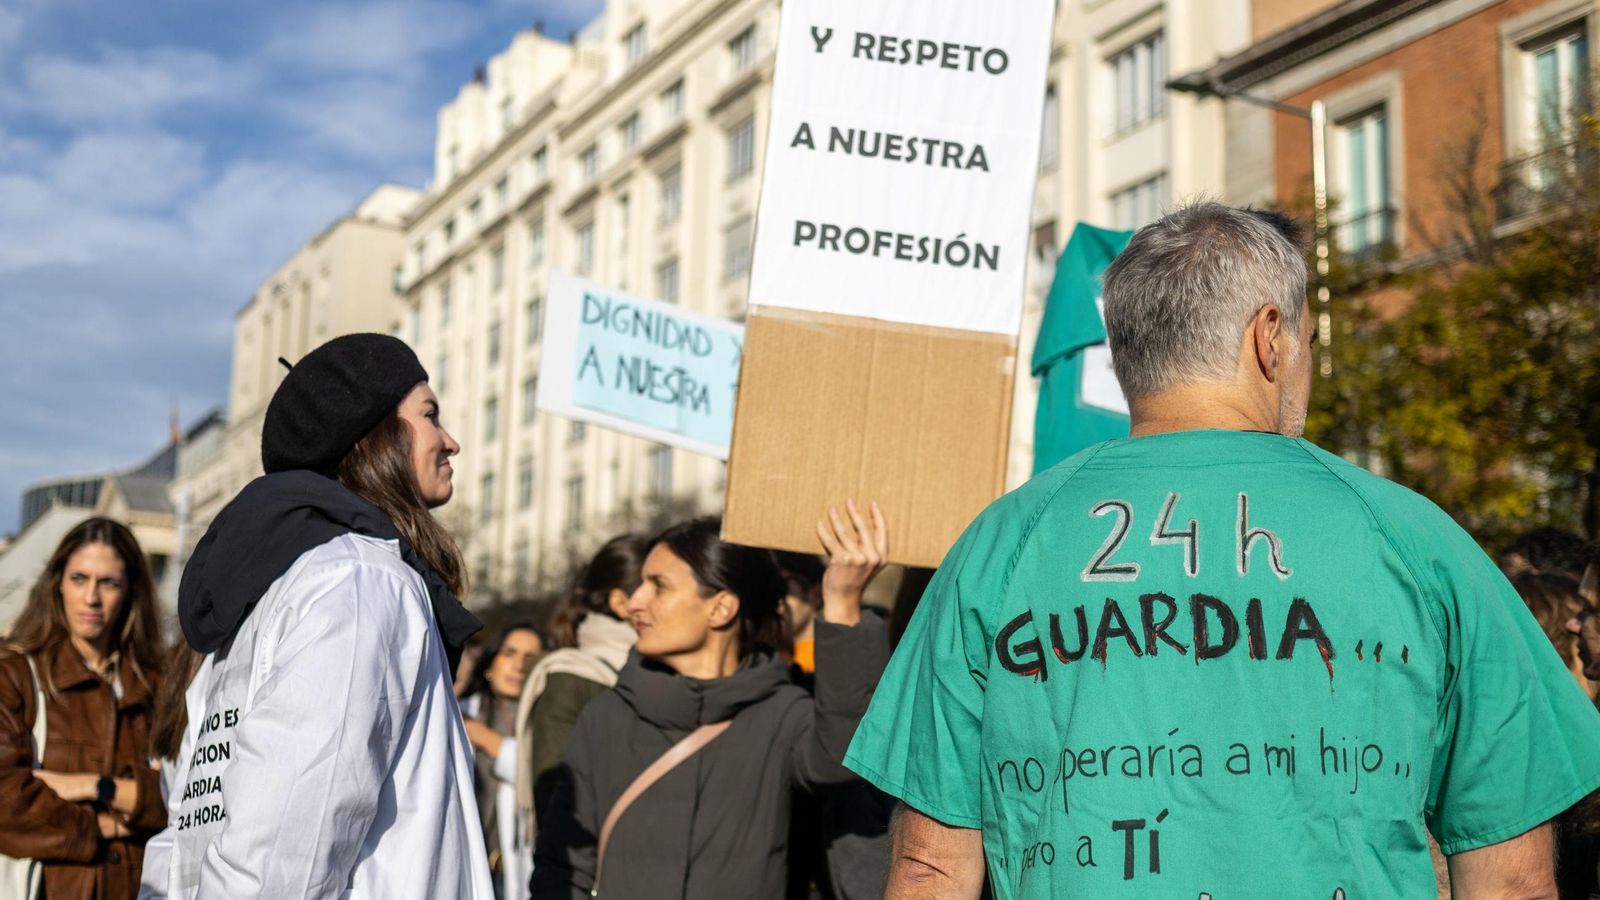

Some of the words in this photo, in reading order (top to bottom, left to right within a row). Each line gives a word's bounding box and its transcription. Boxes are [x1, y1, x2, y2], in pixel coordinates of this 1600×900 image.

[810, 26, 834, 53] Y
[852, 32, 1009, 75] RESPETO
[790, 122, 816, 150] A
[828, 126, 990, 172] NUESTRA
[793, 220, 1000, 271] PROFESIÓN
[581, 291, 714, 357] DIGNIDAD
[577, 344, 604, 387] A
[615, 354, 711, 415] NUESTRA
[1081, 491, 1200, 582] 24
[1236, 491, 1293, 580] h
[225, 707, 239, 728] ES
[997, 757, 1045, 792] no
[1224, 742, 1251, 777] a
[1264, 734, 1296, 776] mi
[182, 776, 222, 803] ARDIA
[178, 813, 191, 831] 24
[1076, 835, 1097, 867] a
